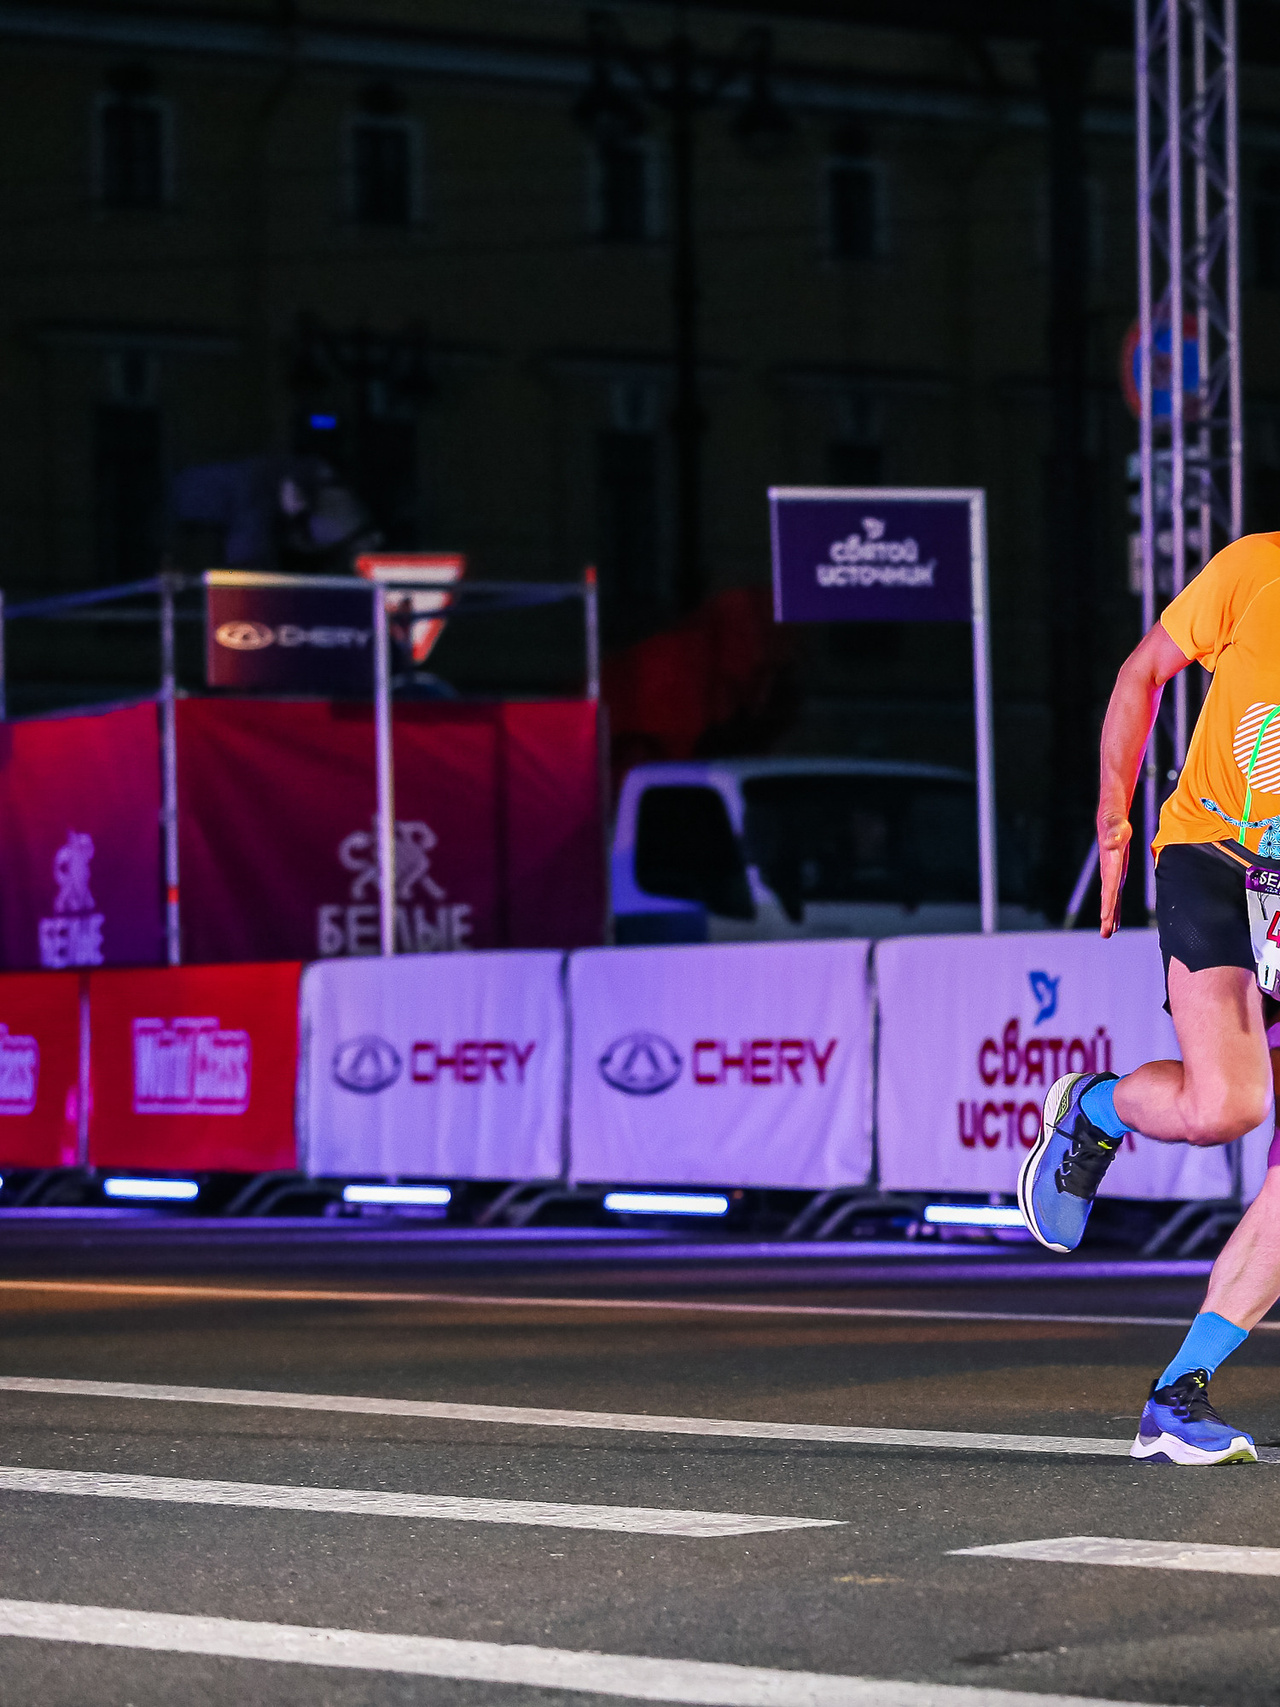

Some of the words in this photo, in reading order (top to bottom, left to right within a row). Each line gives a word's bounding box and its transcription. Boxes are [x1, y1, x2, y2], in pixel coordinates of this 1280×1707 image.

[276, 624, 373, 648] CHERY
[411, 1040, 535, 1084] CHERY
[693, 1039, 837, 1086] CHERY
